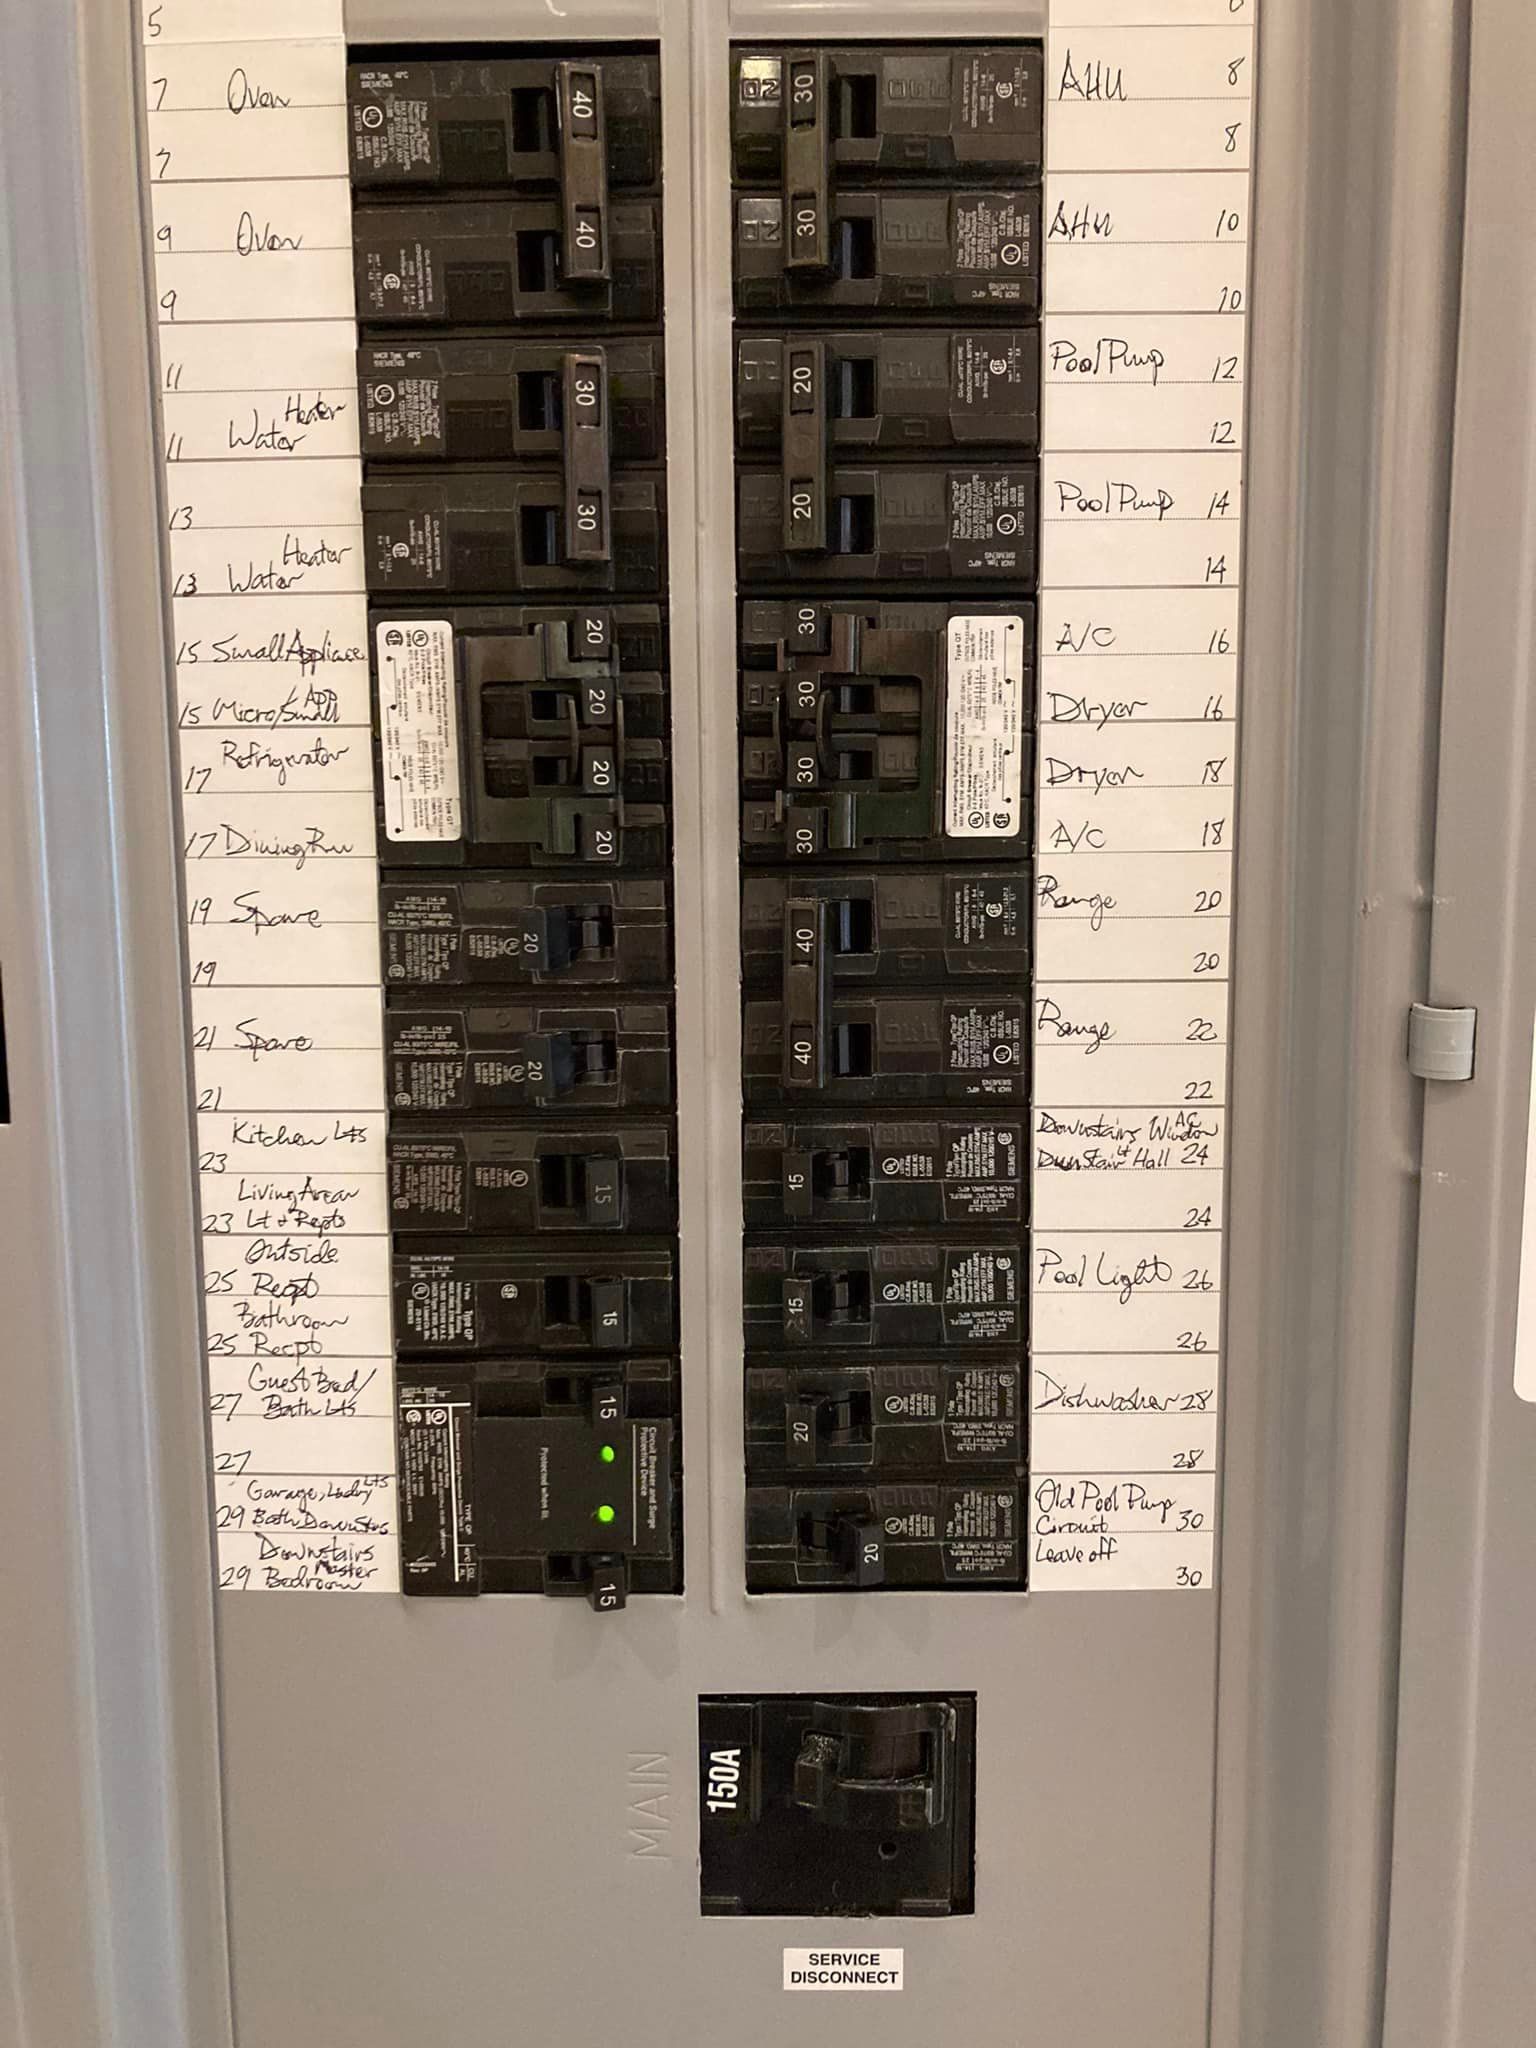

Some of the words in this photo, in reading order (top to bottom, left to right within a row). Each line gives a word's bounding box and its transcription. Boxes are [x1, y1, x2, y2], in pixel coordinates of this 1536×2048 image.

[148, 5, 162, 37] 5
[1058, 48, 1127, 101] AHU
[1228, 57, 1245, 86] 8
[152, 78, 168, 111] 7
[227, 68, 291, 114] Oven
[794, 73, 814, 104] 30
[572, 90, 593, 119] 40
[1225, 122, 1242, 152] 8
[155, 148, 171, 178] 7
[156, 224, 172, 250] 9
[237, 211, 302, 256] Oven
[796, 208, 817, 237] 30
[1048, 200, 1113, 240] AHU
[1216, 209, 1239, 238] 10
[575, 221, 596, 249] 40
[160, 290, 177, 320] 9
[1218, 286, 1242, 313] 10
[166, 363, 183, 389] 11
[793, 366, 813, 394] 20
[1212, 356, 1238, 383] 12
[575, 379, 596, 407] 30
[166, 432, 183, 461] 11
[229, 408, 306, 452] Water
[285, 391, 346, 425] Heater
[1210, 421, 1235, 443] 12
[169, 506, 193, 530] 13
[577, 504, 597, 531] 30
[792, 493, 812, 520] 20
[1207, 490, 1230, 519] 14
[173, 573, 198, 597] 13
[227, 560, 304, 593] Water
[282, 533, 352, 566] Heater
[1205, 555, 1226, 584] 14
[585, 619, 604, 644] 20
[798, 608, 816, 635] 30
[1056, 622, 1117, 652] A/C
[1208, 628, 1229, 654] 16
[177, 640, 201, 665] 15
[589, 689, 606, 714] 20
[798, 681, 816, 708] 30
[179, 702, 201, 727] 15
[1047, 691, 1148, 731] Dryer
[1204, 694, 1223, 721] 16
[185, 766, 212, 794] 17
[592, 760, 610, 786] 20
[796, 757, 814, 784] 30
[1045, 757, 1144, 795] Dryer
[1202, 757, 1227, 784] 18
[185, 832, 217, 859] 17
[595, 830, 613, 855] 20
[796, 829, 813, 855] 30
[1050, 819, 1106, 853] A/C
[1202, 818, 1225, 846] 18
[191, 897, 212, 925] 19
[230, 891, 322, 935] Spare
[1036, 875, 1117, 931] Range
[1194, 890, 1222, 912] 20
[523, 933, 538, 953] 20
[795, 928, 814, 953] 40
[193, 961, 217, 986] 19
[1193, 952, 1220, 973] 20
[194, 1025, 216, 1051] 21
[234, 1018, 313, 1062] Spare
[1035, 998, 1116, 1055] Range
[1186, 1018, 1217, 1041] 22
[794, 1041, 813, 1065] 40
[527, 1061, 543, 1082] 20
[197, 1086, 221, 1111] 21
[1184, 1081, 1213, 1100] 22
[232, 1117, 327, 1147] Kitchen
[200, 1152, 228, 1173] 23
[1133, 1147, 1170, 1169] Hall
[1181, 1143, 1208, 1166] 24
[594, 1184, 612, 1204] 15
[788, 1173, 805, 1191] 15
[238, 1178, 298, 1214] Living
[203, 1213, 234, 1234] 23
[1183, 1206, 1211, 1228] 24
[245, 1238, 339, 1264] Outside
[204, 1269, 238, 1293] 25
[1036, 1248, 1086, 1287] Pool
[1097, 1251, 1172, 1304] Light
[1182, 1269, 1213, 1290] 26
[233, 1300, 349, 1329] Bathroom
[602, 1311, 618, 1327] 15
[788, 1297, 805, 1315] 15
[208, 1334, 239, 1355] 25
[1176, 1332, 1207, 1352] 26
[248, 1363, 311, 1392] Guest
[1035, 1370, 1180, 1411] Dishwasher
[1180, 1389, 1213, 1411] 28
[210, 1393, 242, 1421] 27
[599, 1395, 617, 1419] 15
[793, 1422, 809, 1443] 20
[216, 1451, 251, 1475] 27
[1173, 1449, 1204, 1469] 28
[217, 1506, 245, 1529] 29
[1035, 1478, 1074, 1513] Old
[1079, 1480, 1119, 1512] Pool
[1122, 1483, 1176, 1524] Pump
[1176, 1509, 1204, 1532] 30
[864, 1543, 880, 1563] 20
[1035, 1538, 1087, 1563] Leave
[1089, 1536, 1118, 1561] off
[219, 1566, 251, 1591] 29
[1176, 1566, 1202, 1587] 30
[599, 1583, 617, 1607] 15
[706, 1748, 741, 1813] 150A
[626, 1751, 671, 1861] MAIN
[808, 1952, 881, 1967] SERVICE
[790, 1970, 899, 1985] DISCONNECT
